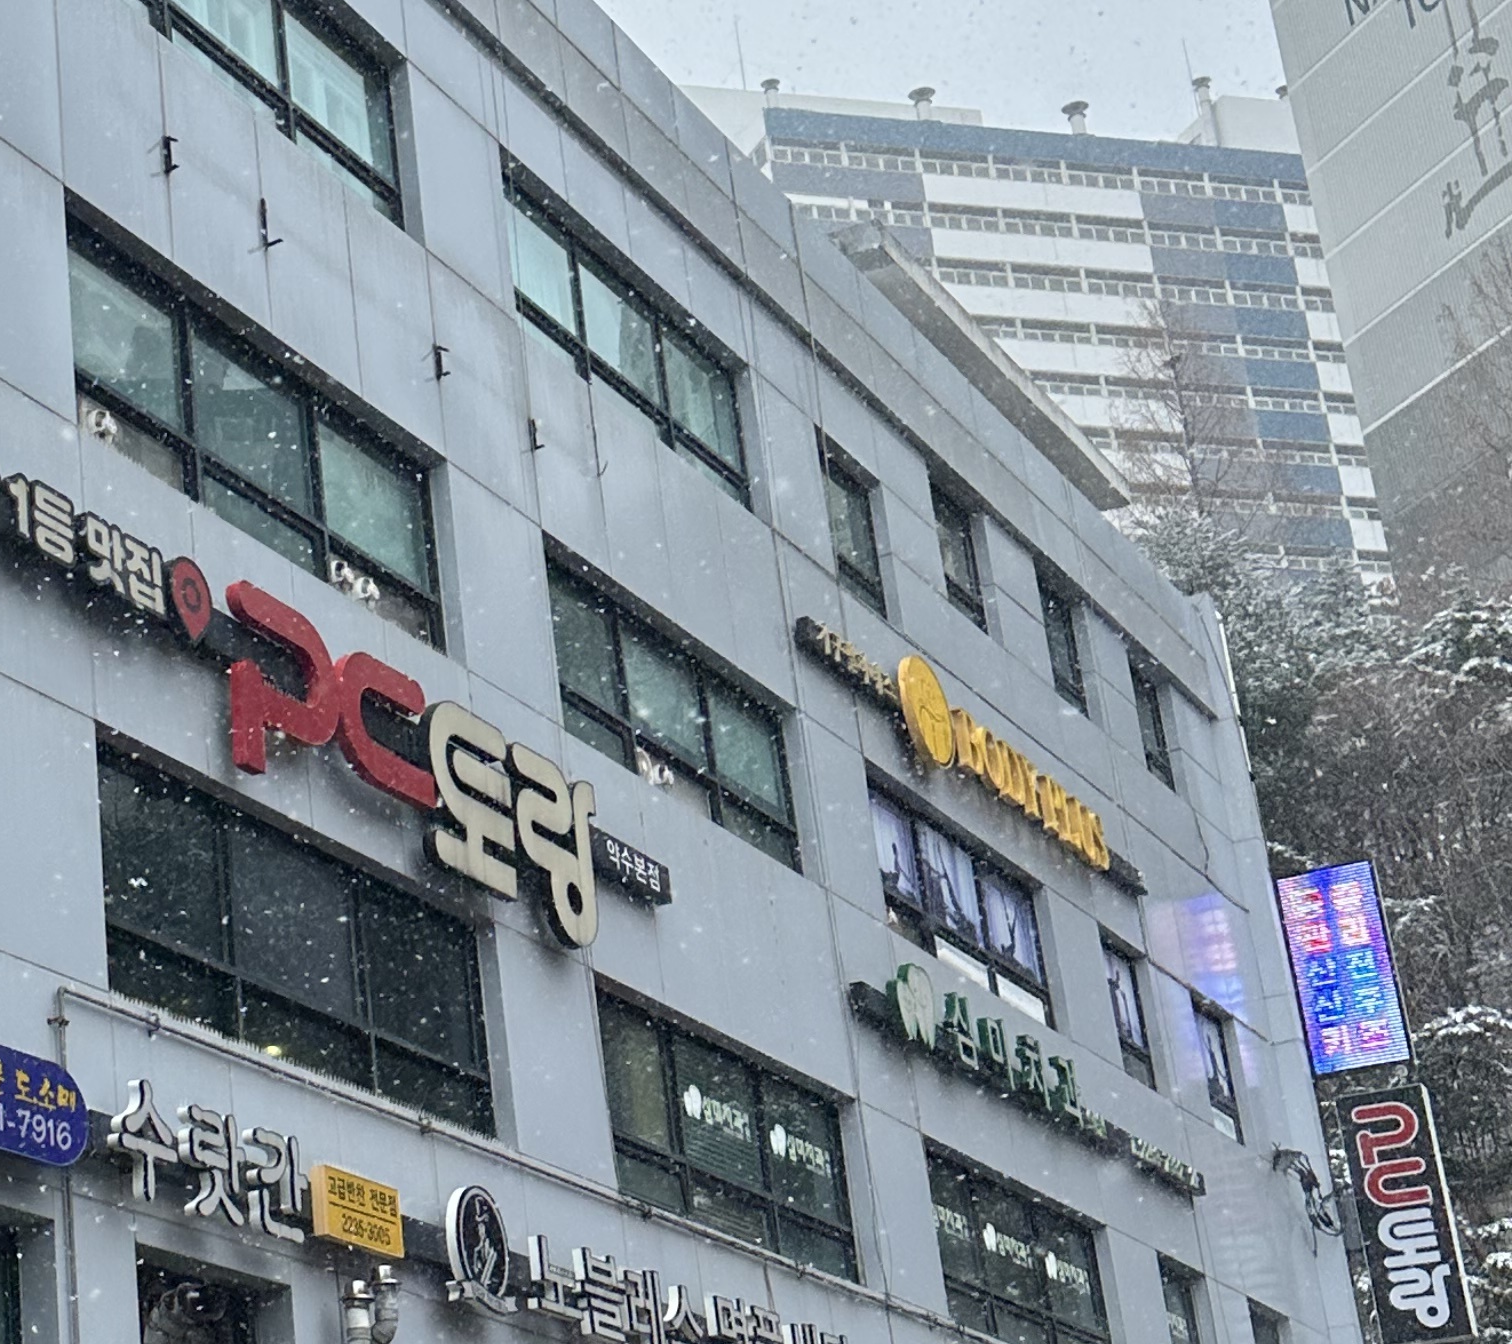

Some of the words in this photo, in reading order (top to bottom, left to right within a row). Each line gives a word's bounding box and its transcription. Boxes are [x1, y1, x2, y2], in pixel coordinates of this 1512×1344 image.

[7, 476, 74, 565] 1등
[86, 513, 166, 619] 맛집
[605, 836, 662, 893] 약수본점
[107, 1079, 308, 1243] 수랏간
